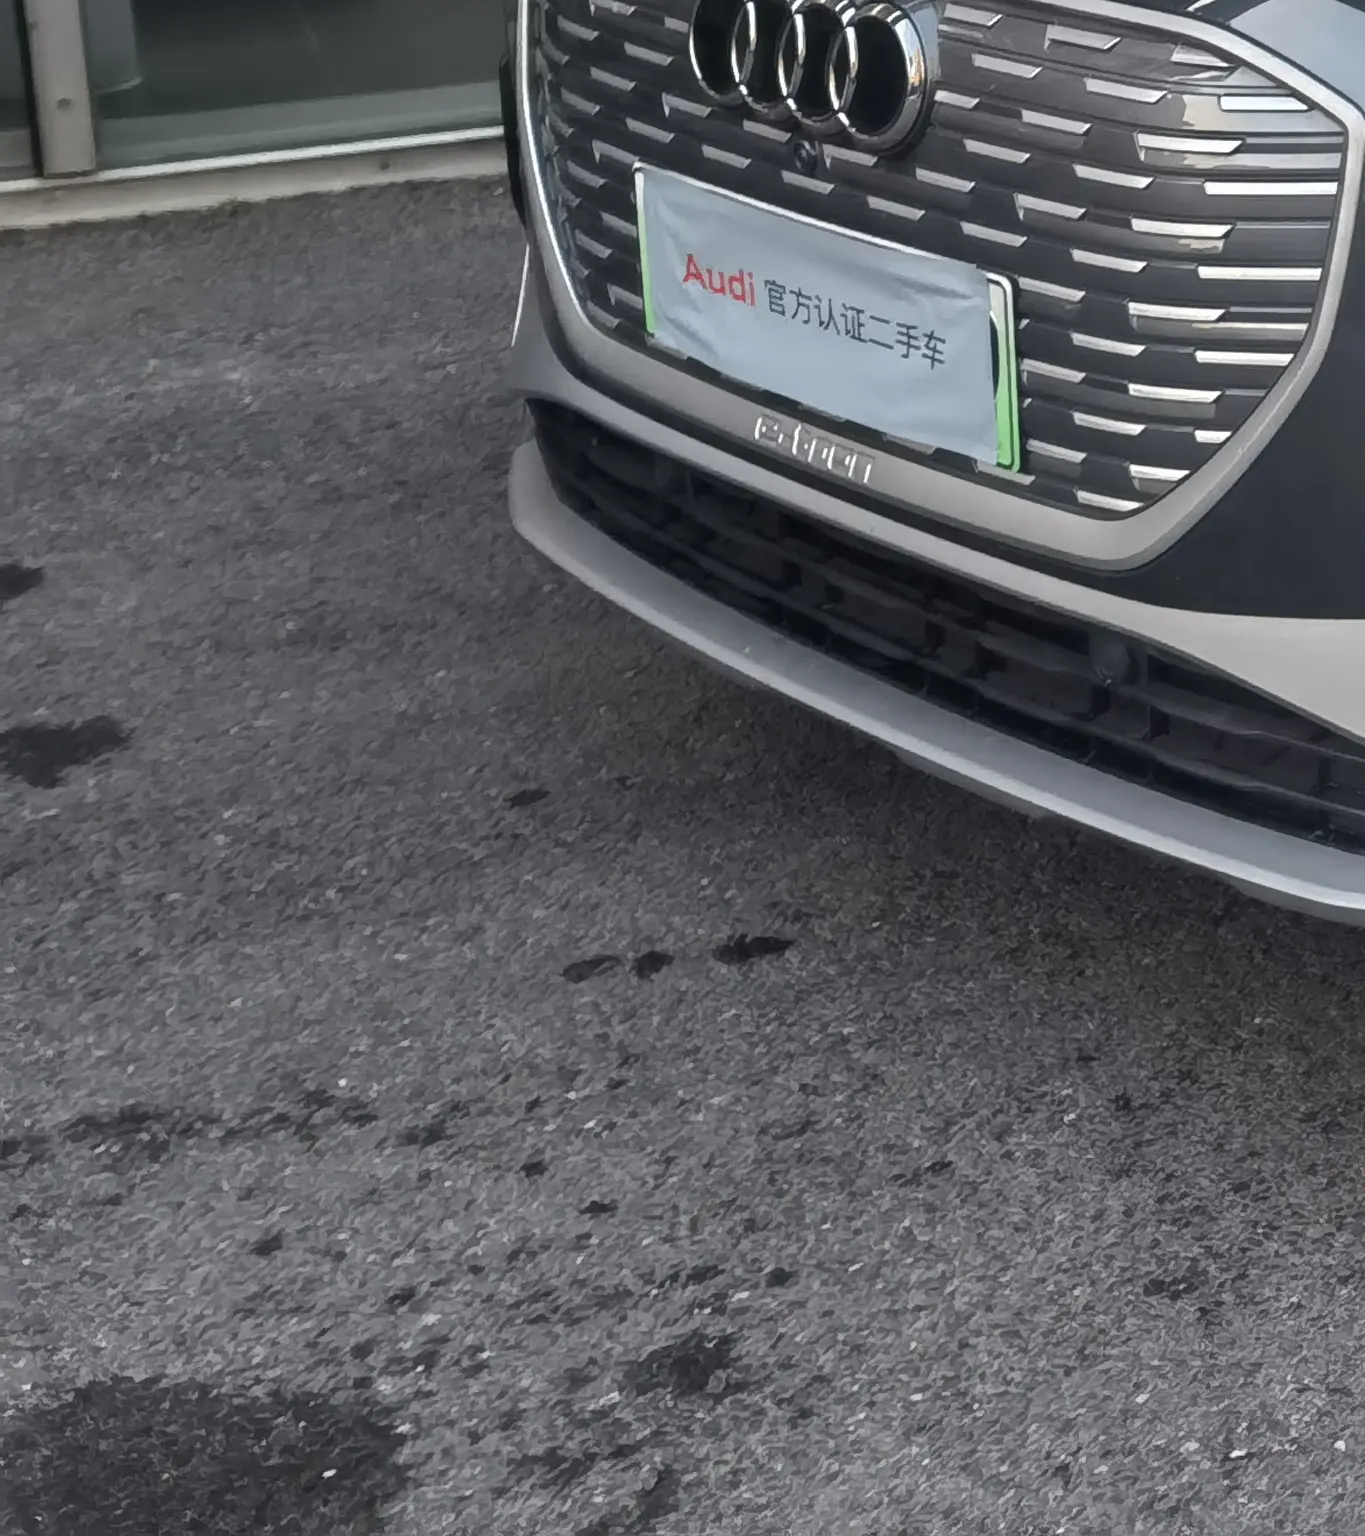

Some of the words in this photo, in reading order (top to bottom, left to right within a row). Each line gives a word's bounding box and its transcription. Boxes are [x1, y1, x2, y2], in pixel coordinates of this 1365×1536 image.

[683, 254, 756, 307] Audi
[764, 280, 946, 369] 官方认证二手车
